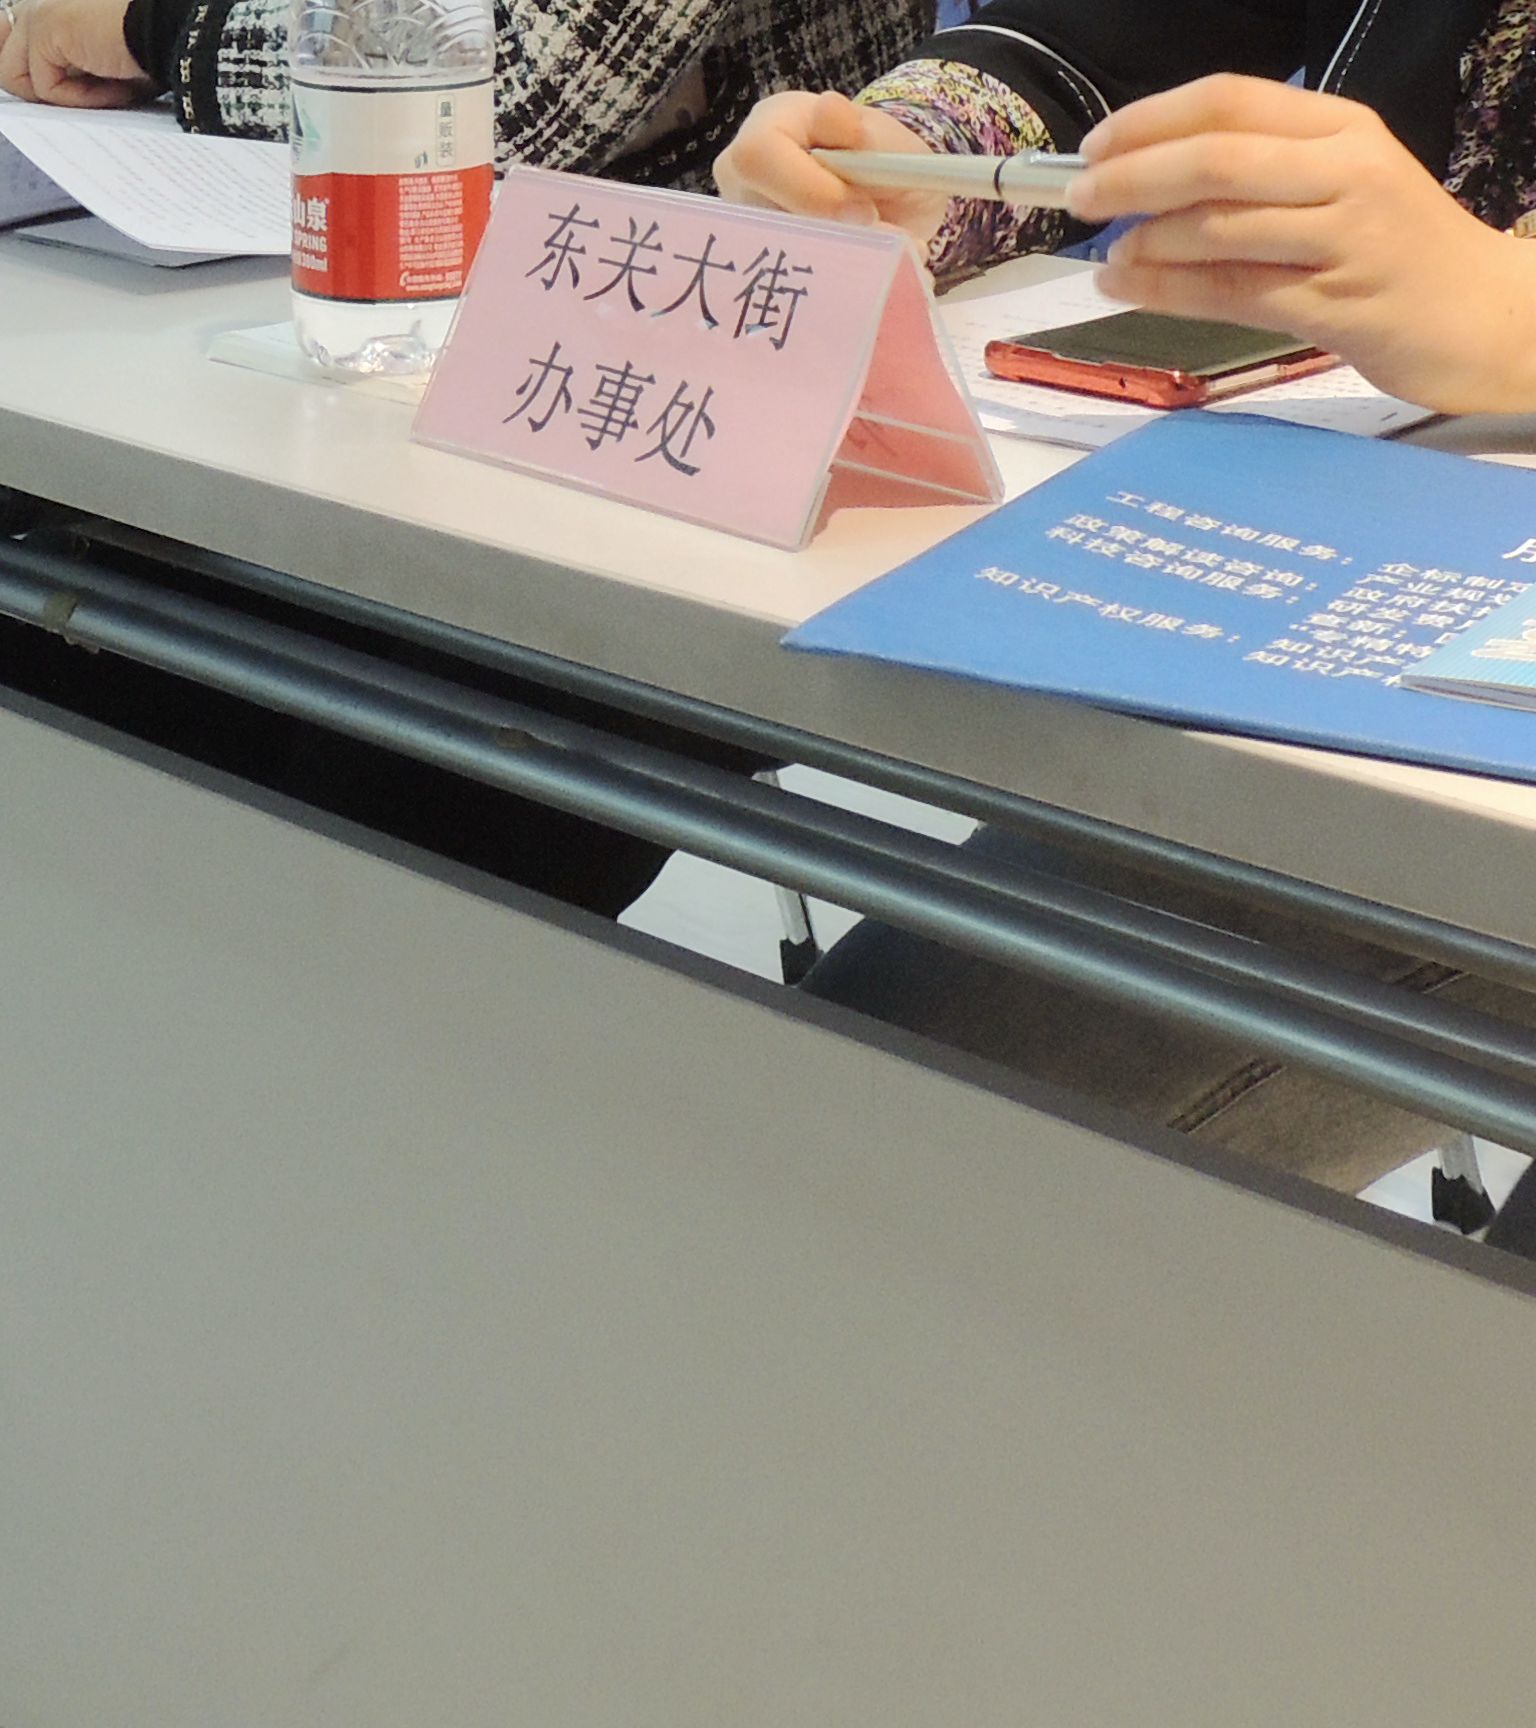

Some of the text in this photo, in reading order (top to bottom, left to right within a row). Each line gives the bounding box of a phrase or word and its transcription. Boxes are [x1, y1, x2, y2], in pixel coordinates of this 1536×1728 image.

[293, 192, 329, 231] 山泉
[524, 202, 814, 352] 东关大街
[501, 340, 717, 477] 办事处
[1045, 525, 1300, 604] 科技咨询服务：
[1106, 490, 1354, 566] 工程咨询服务：
[974, 565, 1241, 644] 知识产权服务：
